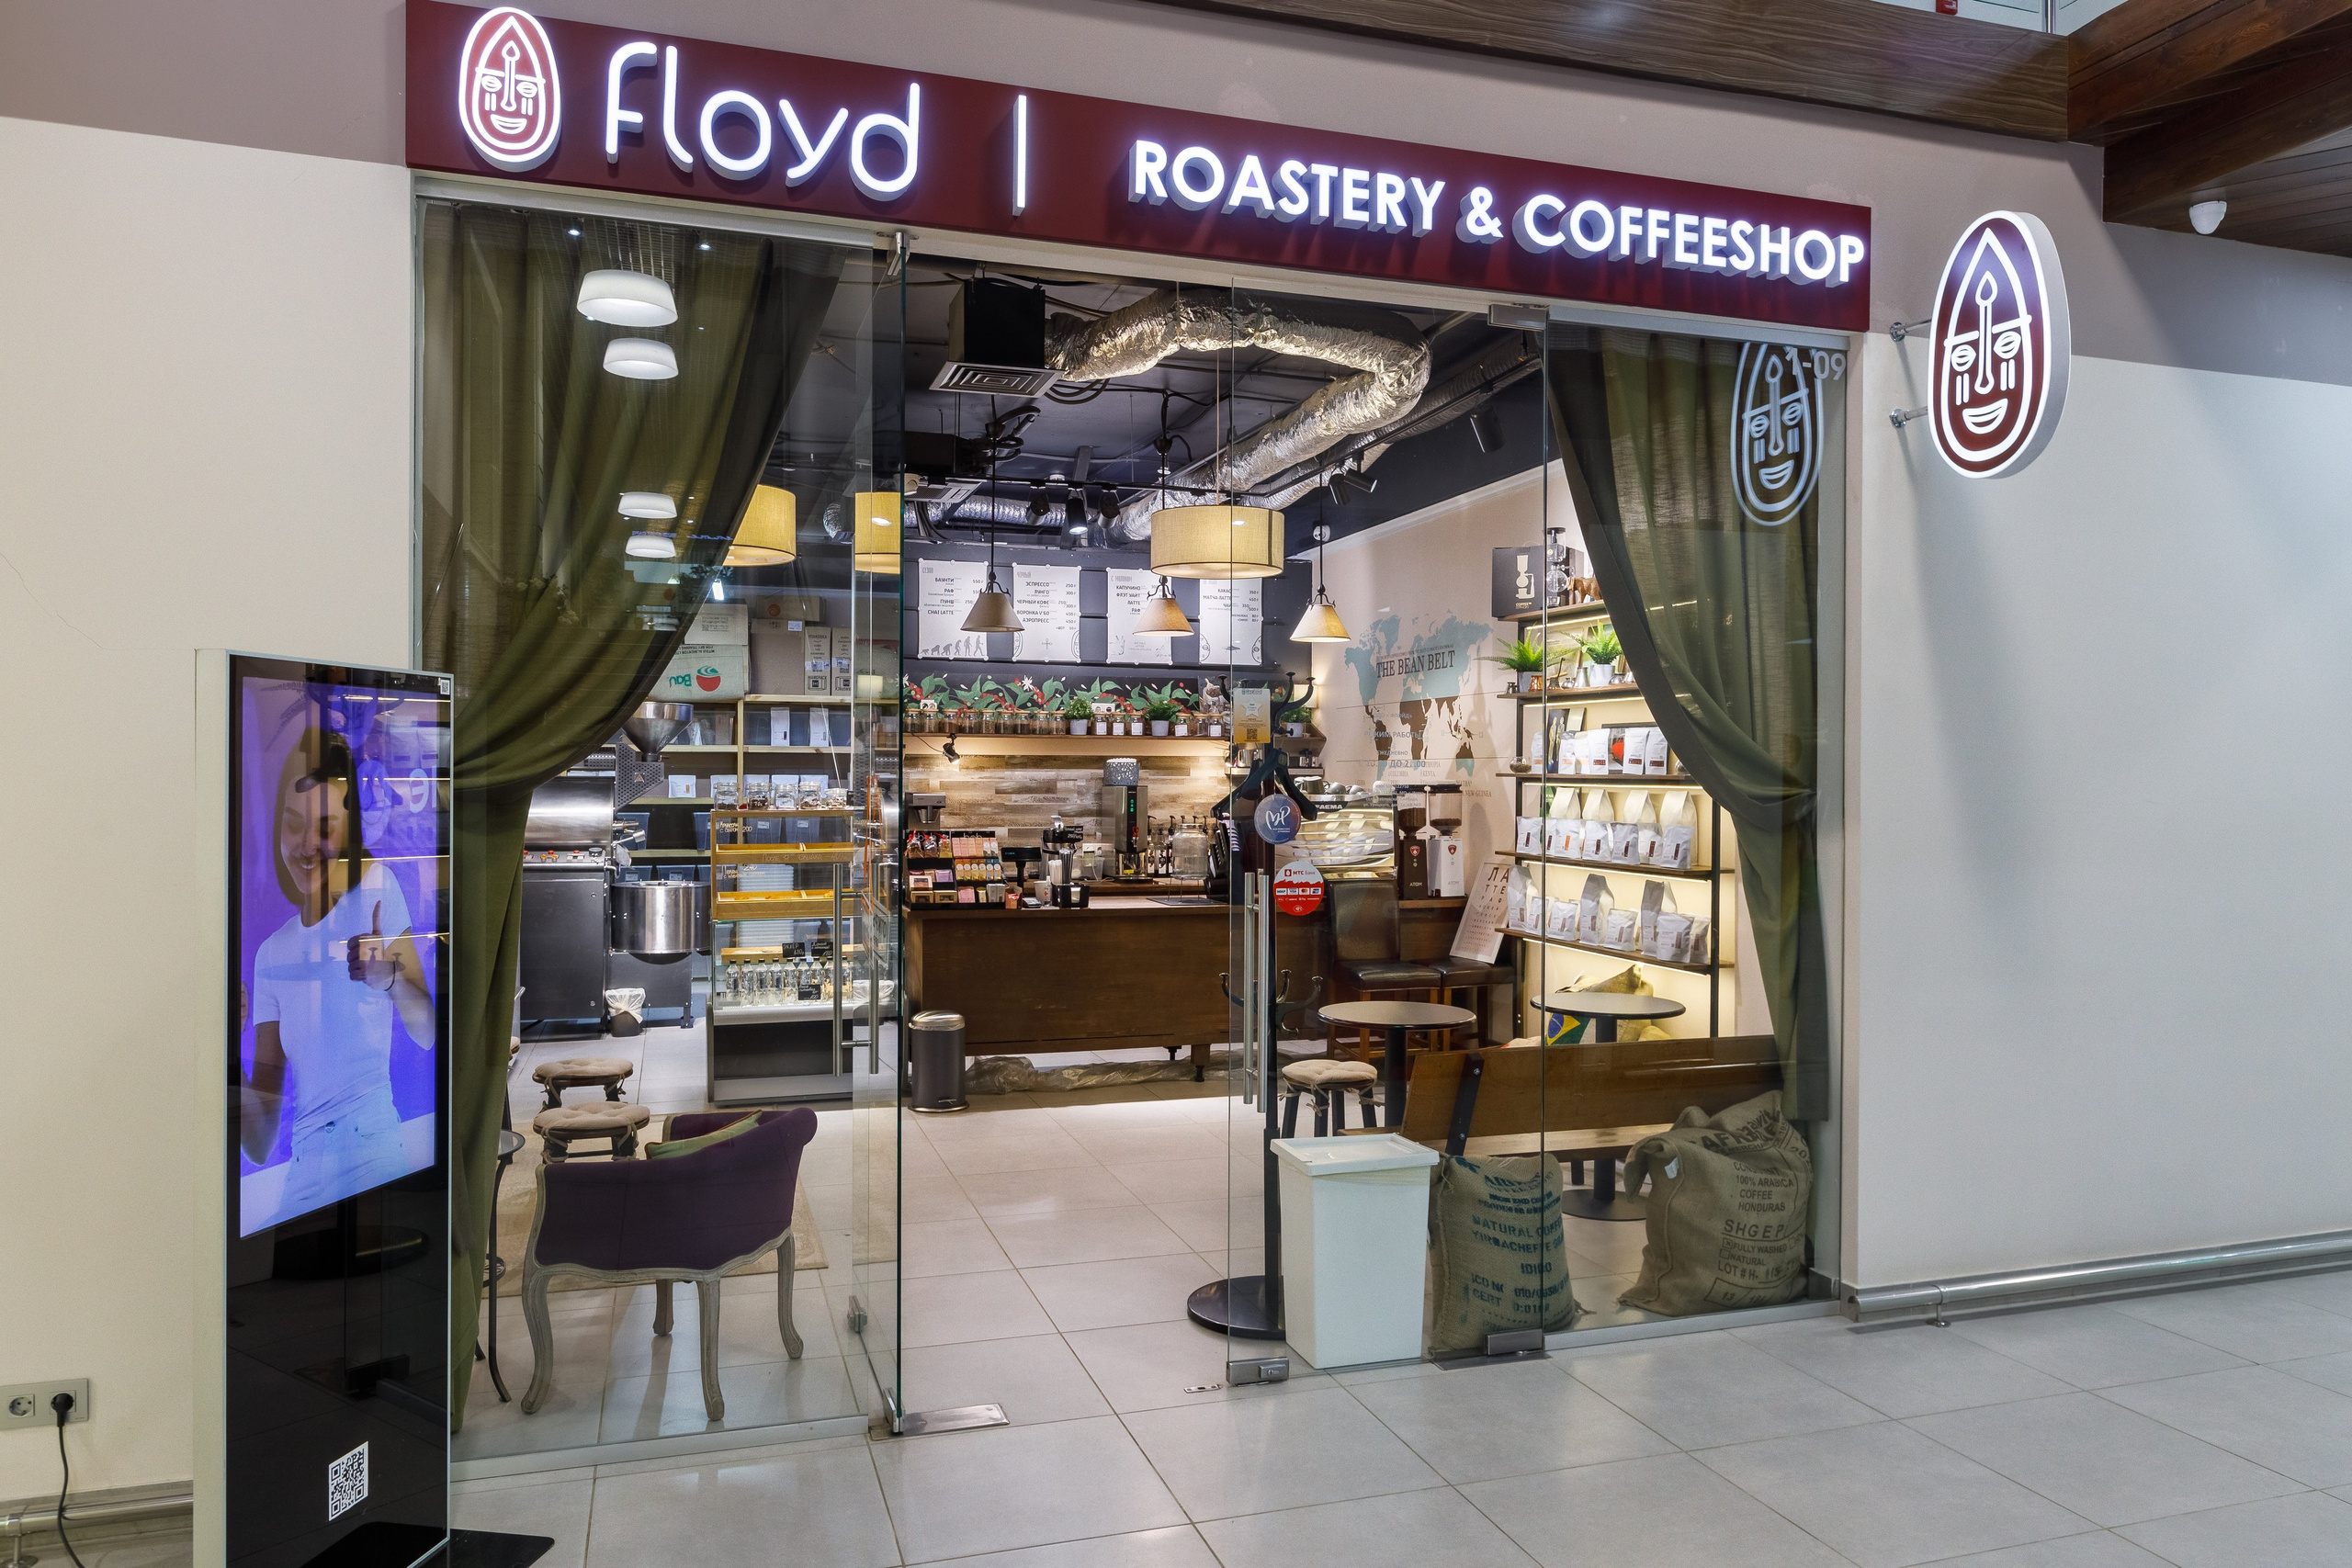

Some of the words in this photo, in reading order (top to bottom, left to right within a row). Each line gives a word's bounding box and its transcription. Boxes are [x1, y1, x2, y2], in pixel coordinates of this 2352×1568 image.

[605, 41, 920, 199] floyd
[1129, 139, 1445, 236] ROASTERY
[1461, 186, 1504, 243] &
[1515, 193, 1865, 287] COFFEESHOP
[1785, 347, 1847, 381] 1-09
[1376, 660, 1395, 678] THE
[1397, 655, 1424, 675] BEAN
[1428, 650, 1455, 671] BELT
[1736, 1175, 1756, 1186] 100%
[1758, 1177, 1793, 1188] ARABICA
[1740, 1189, 1772, 1200] COFFEE
[1737, 1201, 1785, 1213] HONDURAS
[1472, 1214, 1533, 1238] NATURAL
[1733, 1242, 1756, 1253] FULLY
[1758, 1243, 1787, 1254] WASHED
[1717, 1260, 1738, 1276] LOT
[1730, 1253, 1766, 1266] NATURAL
[1472, 1288, 1502, 1306] CERT
